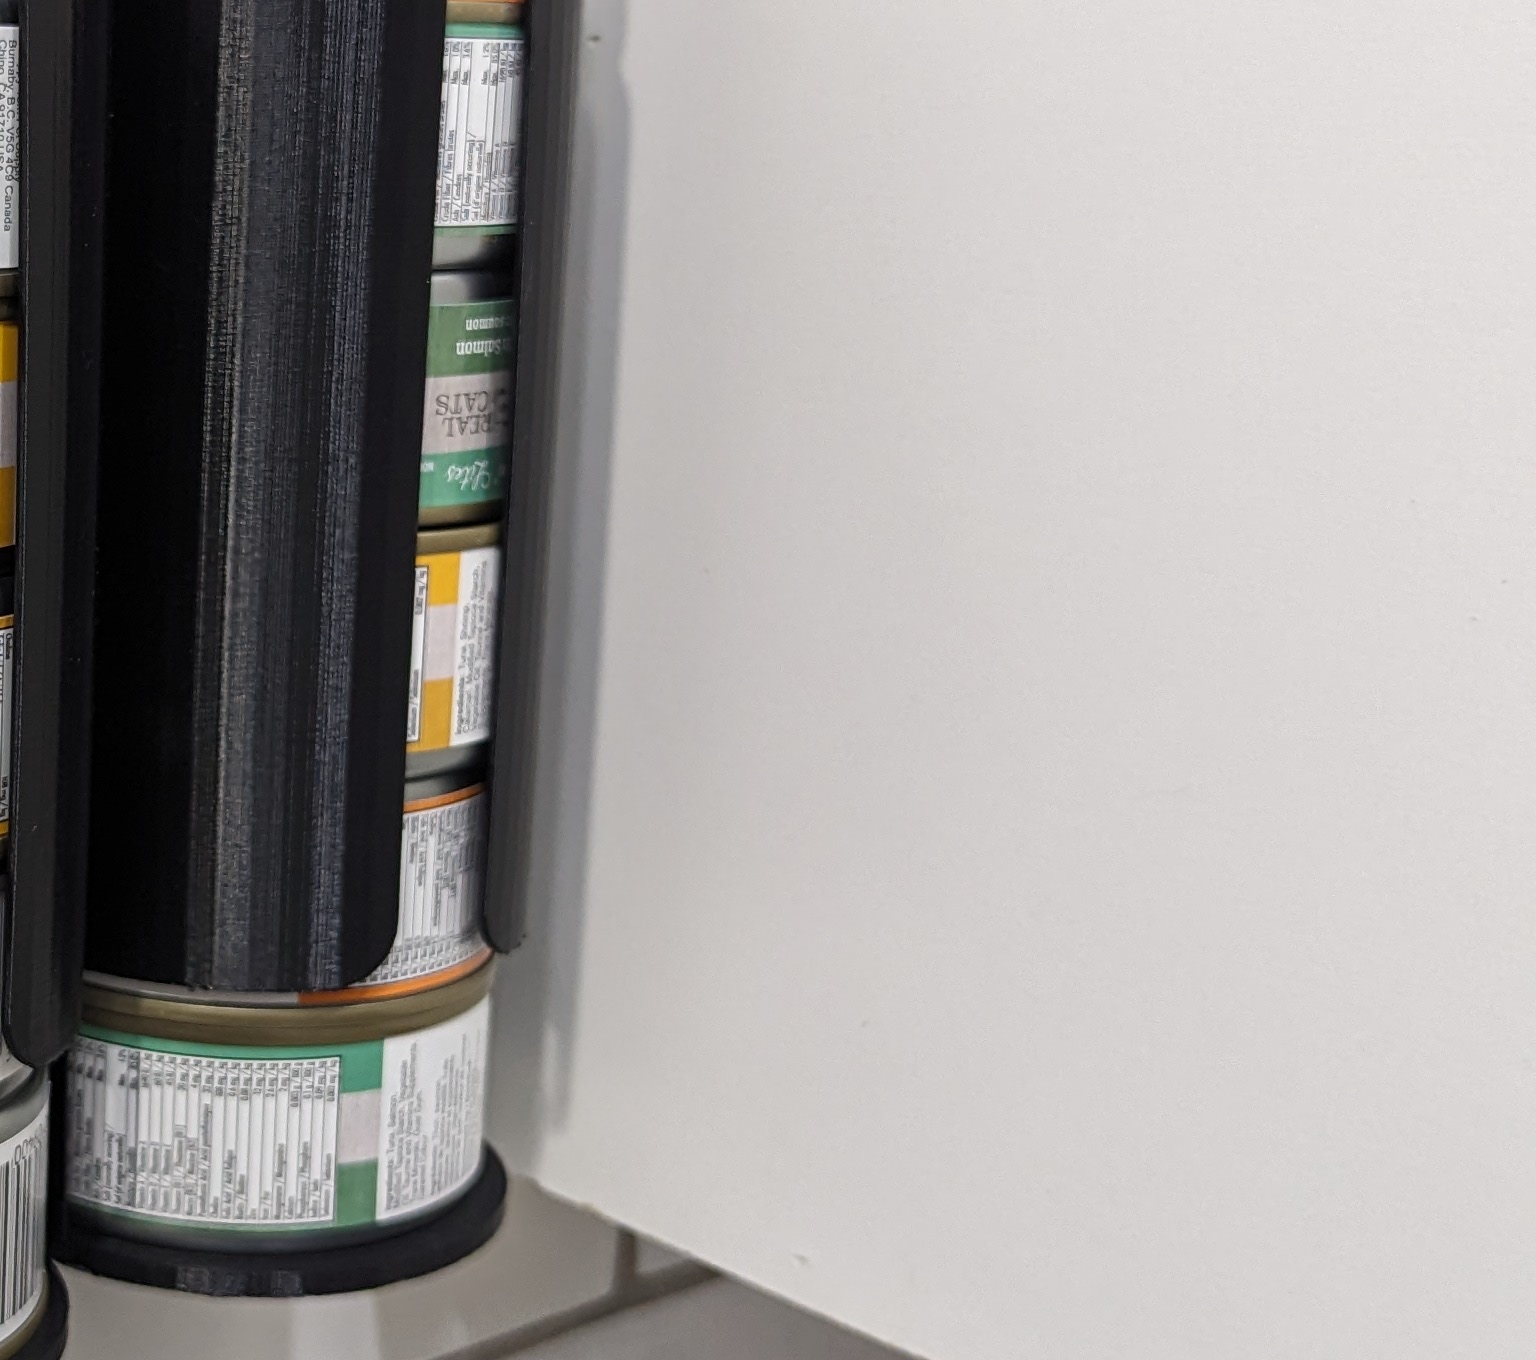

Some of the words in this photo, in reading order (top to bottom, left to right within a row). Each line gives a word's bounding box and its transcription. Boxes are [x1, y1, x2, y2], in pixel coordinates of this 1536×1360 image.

[7, 97, 15, 122] B.C.
[6, 127, 14, 153] V5G
[5, 157, 14, 181] 4C9
[4, 186, 13, 232] Canada
[436, 390, 488, 416] CATS
[442, 413, 492, 437] REAL
[445, 460, 490, 491] Lites
